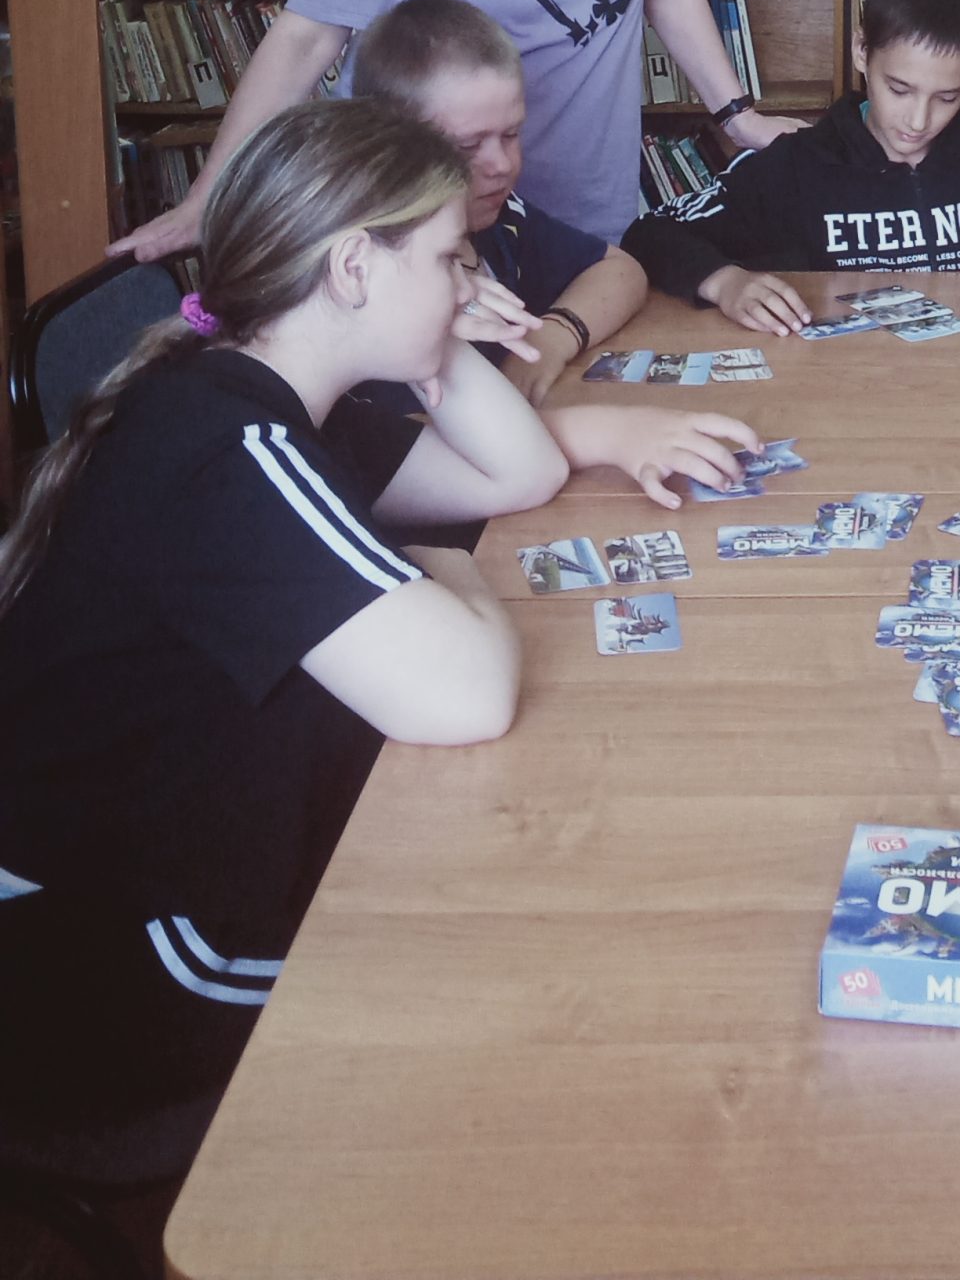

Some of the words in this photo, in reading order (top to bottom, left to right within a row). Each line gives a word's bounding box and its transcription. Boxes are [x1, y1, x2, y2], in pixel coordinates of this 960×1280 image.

[193, 61, 212, 83] П
[836, 258, 857, 267] THAT
[857, 257, 877, 265] THEY
[897, 253, 929, 265] BECOME
[936, 252, 956, 261] LESS
[876, 838, 904, 854] 50
[843, 971, 869, 993] 50
